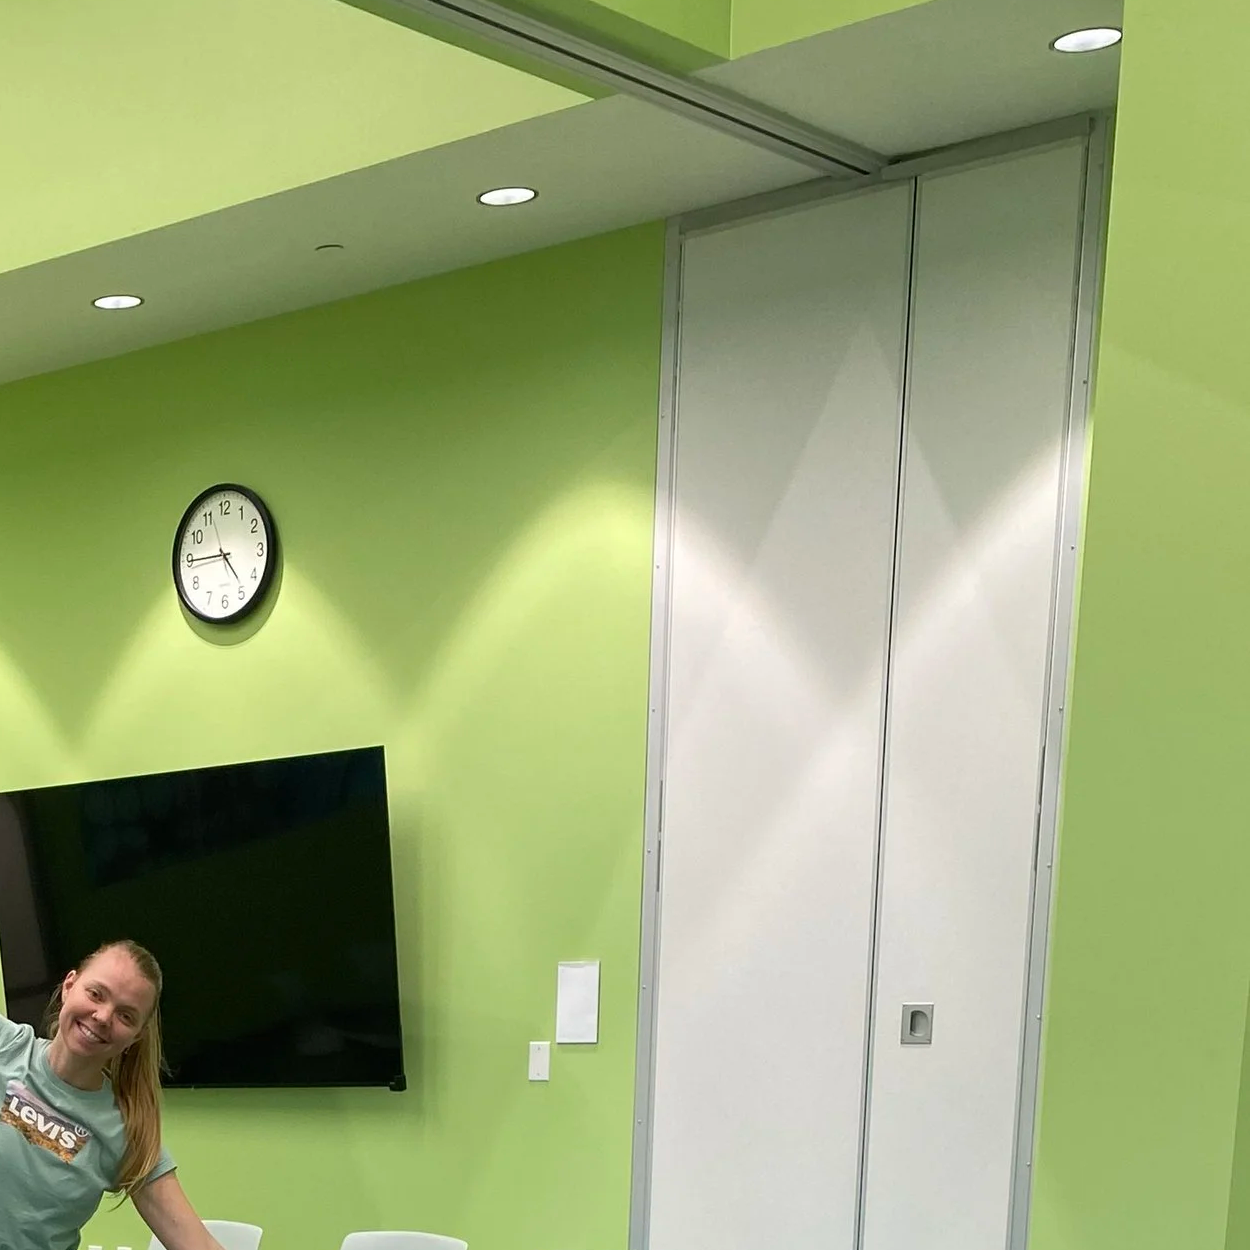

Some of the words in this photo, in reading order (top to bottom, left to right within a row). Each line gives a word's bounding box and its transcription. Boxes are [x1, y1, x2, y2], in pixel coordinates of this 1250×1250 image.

[218, 500, 231, 516] 12
[238, 505, 244, 521] 1
[203, 511, 213, 527] 11
[250, 518, 258, 534] 2
[191, 529, 204, 545] 10
[256, 542, 264, 557] 3
[186, 553, 194, 568] 9
[250, 567, 257, 581] 4
[192, 575, 200, 590] 8
[206, 591, 213, 606] 7
[237, 585, 246, 601] 5
[221, 594, 229, 609] 6
